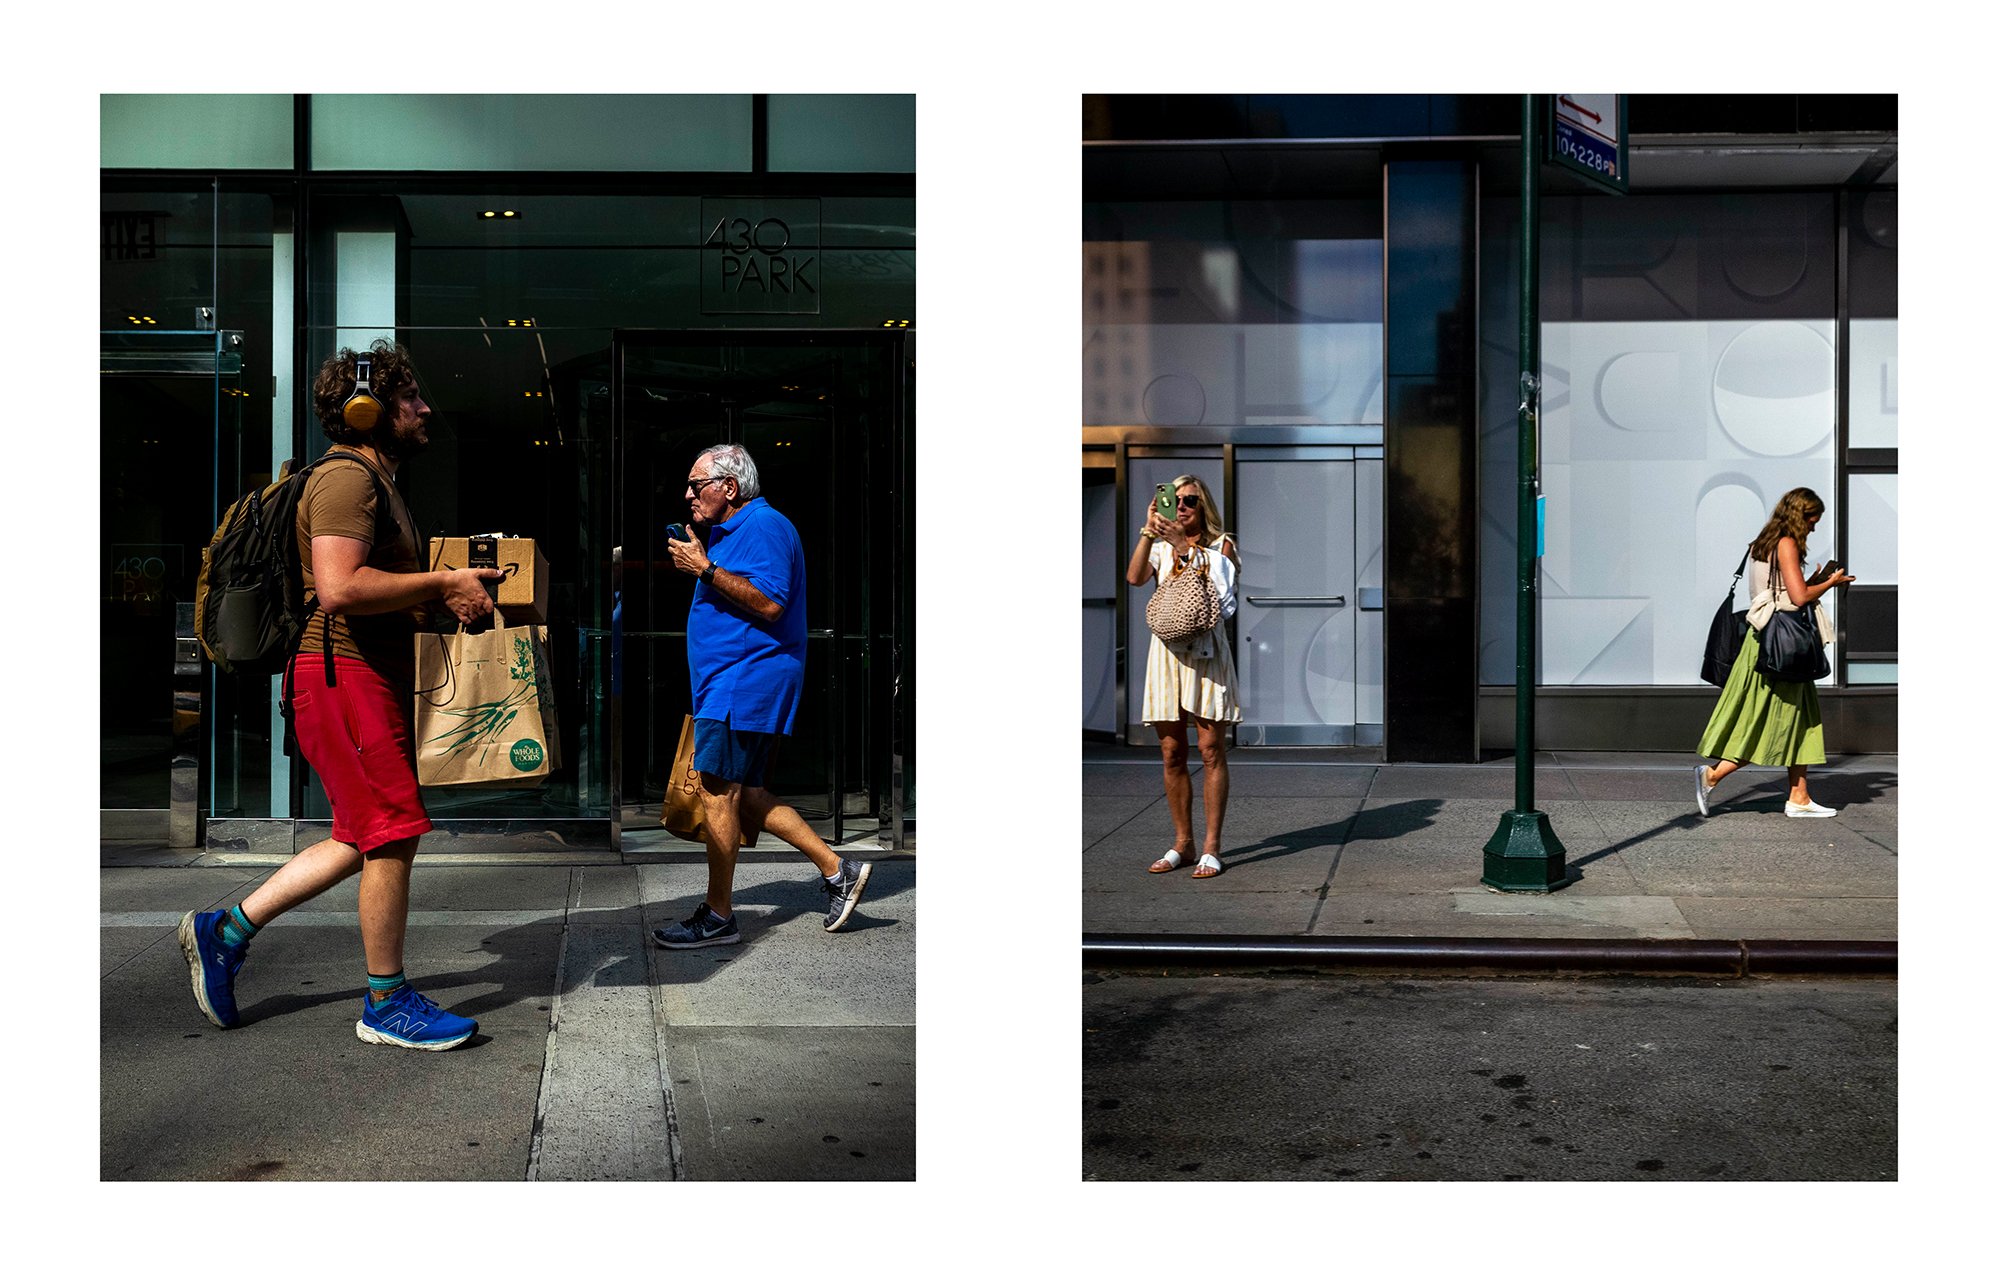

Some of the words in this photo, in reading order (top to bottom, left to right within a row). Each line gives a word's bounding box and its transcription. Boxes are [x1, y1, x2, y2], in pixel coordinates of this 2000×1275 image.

[705, 216, 790, 255] 430
[721, 255, 816, 293] PARK
[113, 556, 166, 580] 430
[512, 747, 540, 756] WHOLE
[514, 754, 540, 762] FOODS
